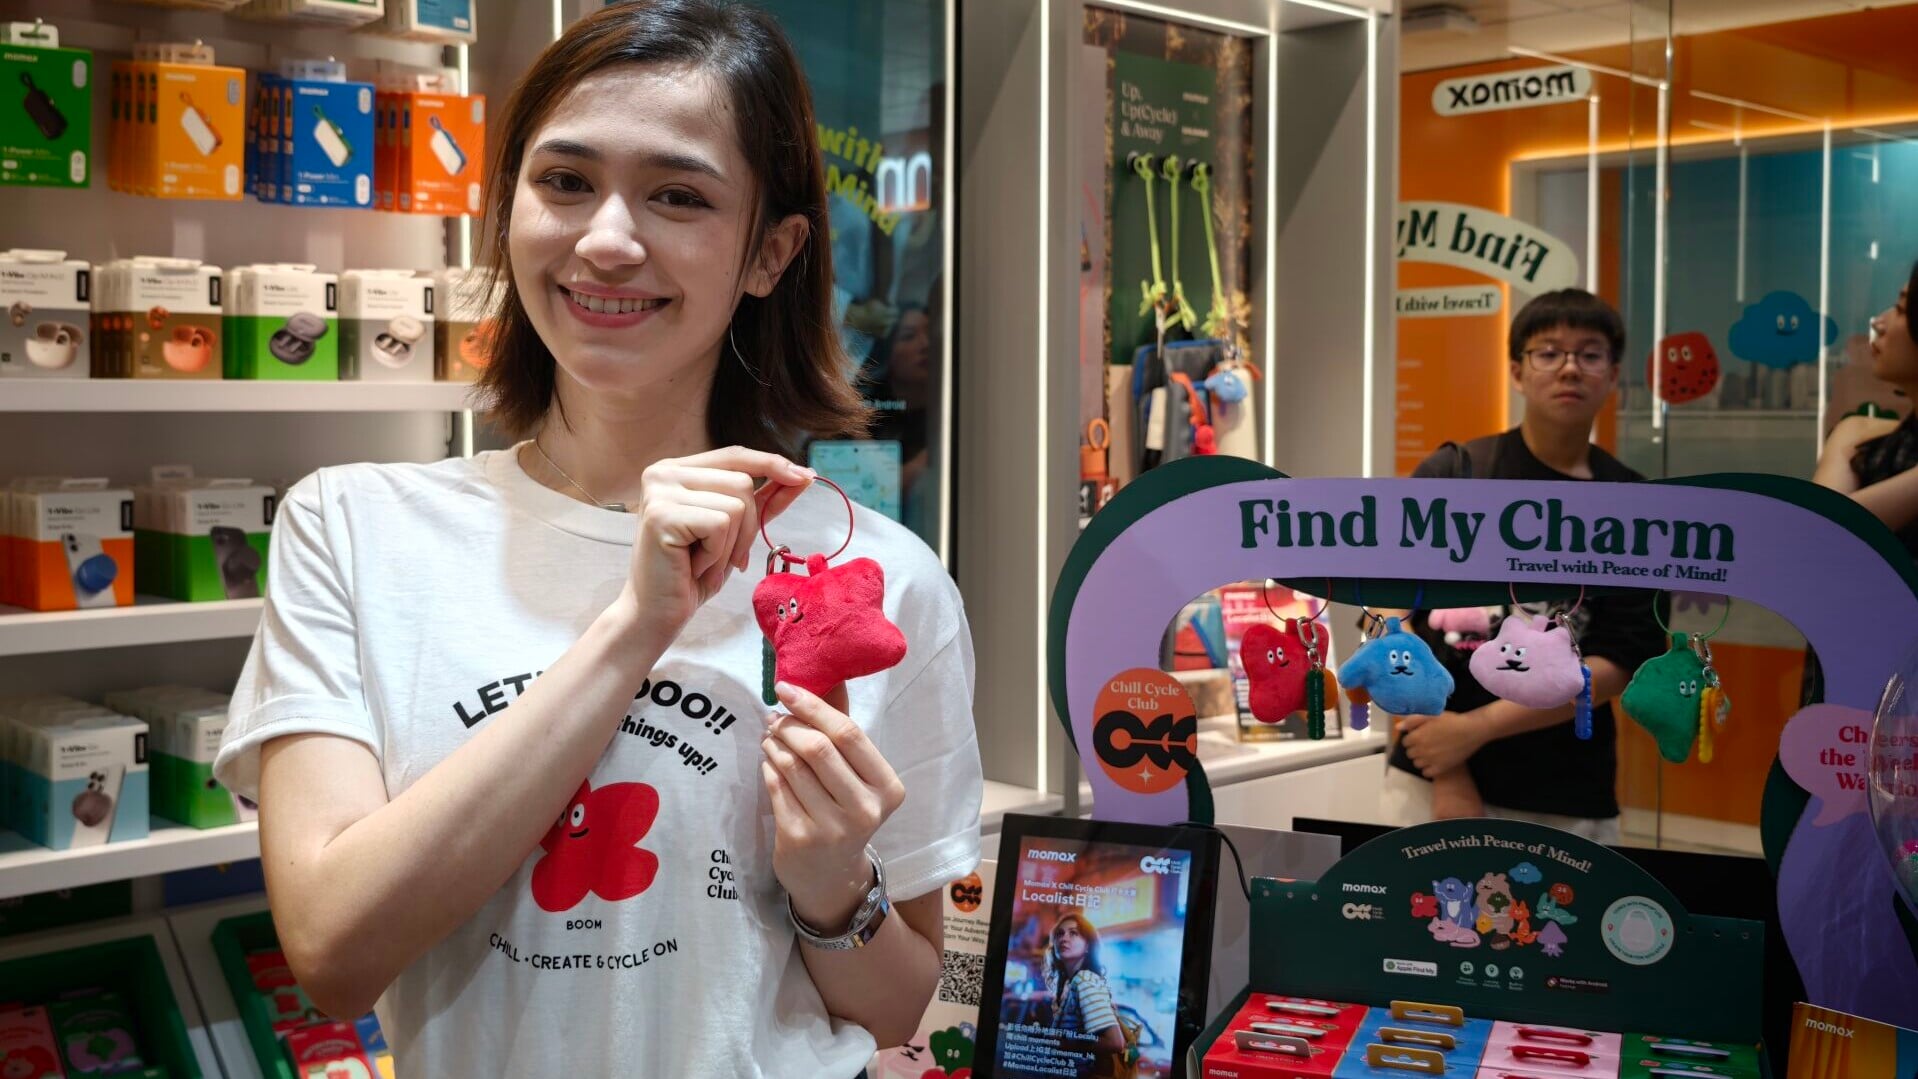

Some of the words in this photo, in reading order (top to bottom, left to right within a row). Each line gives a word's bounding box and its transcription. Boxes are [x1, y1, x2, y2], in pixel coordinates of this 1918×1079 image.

[1239, 495, 1378, 549] Find
[1400, 497, 1486, 563] My
[1499, 498, 1735, 562] Charm
[1507, 557, 1558, 573] Travel
[1561, 561, 1598, 574] with
[1602, 562, 1648, 577] Peace
[1652, 564, 1672, 578] of
[1676, 566, 1727, 582] Mind!
[1110, 680, 1141, 694] Chill
[1144, 682, 1180, 698] Cycle
[1127, 697, 1159, 710] Club
[617, 715, 678, 749] hings
[678, 742, 719, 776] up!!
[1819, 748, 1856, 767] the
[711, 849, 731, 864] Ch
[1027, 848, 1077, 863] momax
[1402, 837, 1448, 860] Travel
[1448, 834, 1481, 849] with
[1484, 834, 1525, 851] Peace
[1527, 843, 1547, 856] of
[1546, 846, 1593, 874] Mind!
[1342, 883, 1387, 894] momax
[566, 919, 602, 930] BOOM
[489, 932, 521, 963] CHILL
[531, 953, 592, 970] CREATE
[596, 954, 605, 968] &
[607, 948, 650, 970] CYCLE
[653, 937, 678, 956] ON
[1805, 1017, 1855, 1039] momax
[1209, 1068, 1239, 1078] momax
